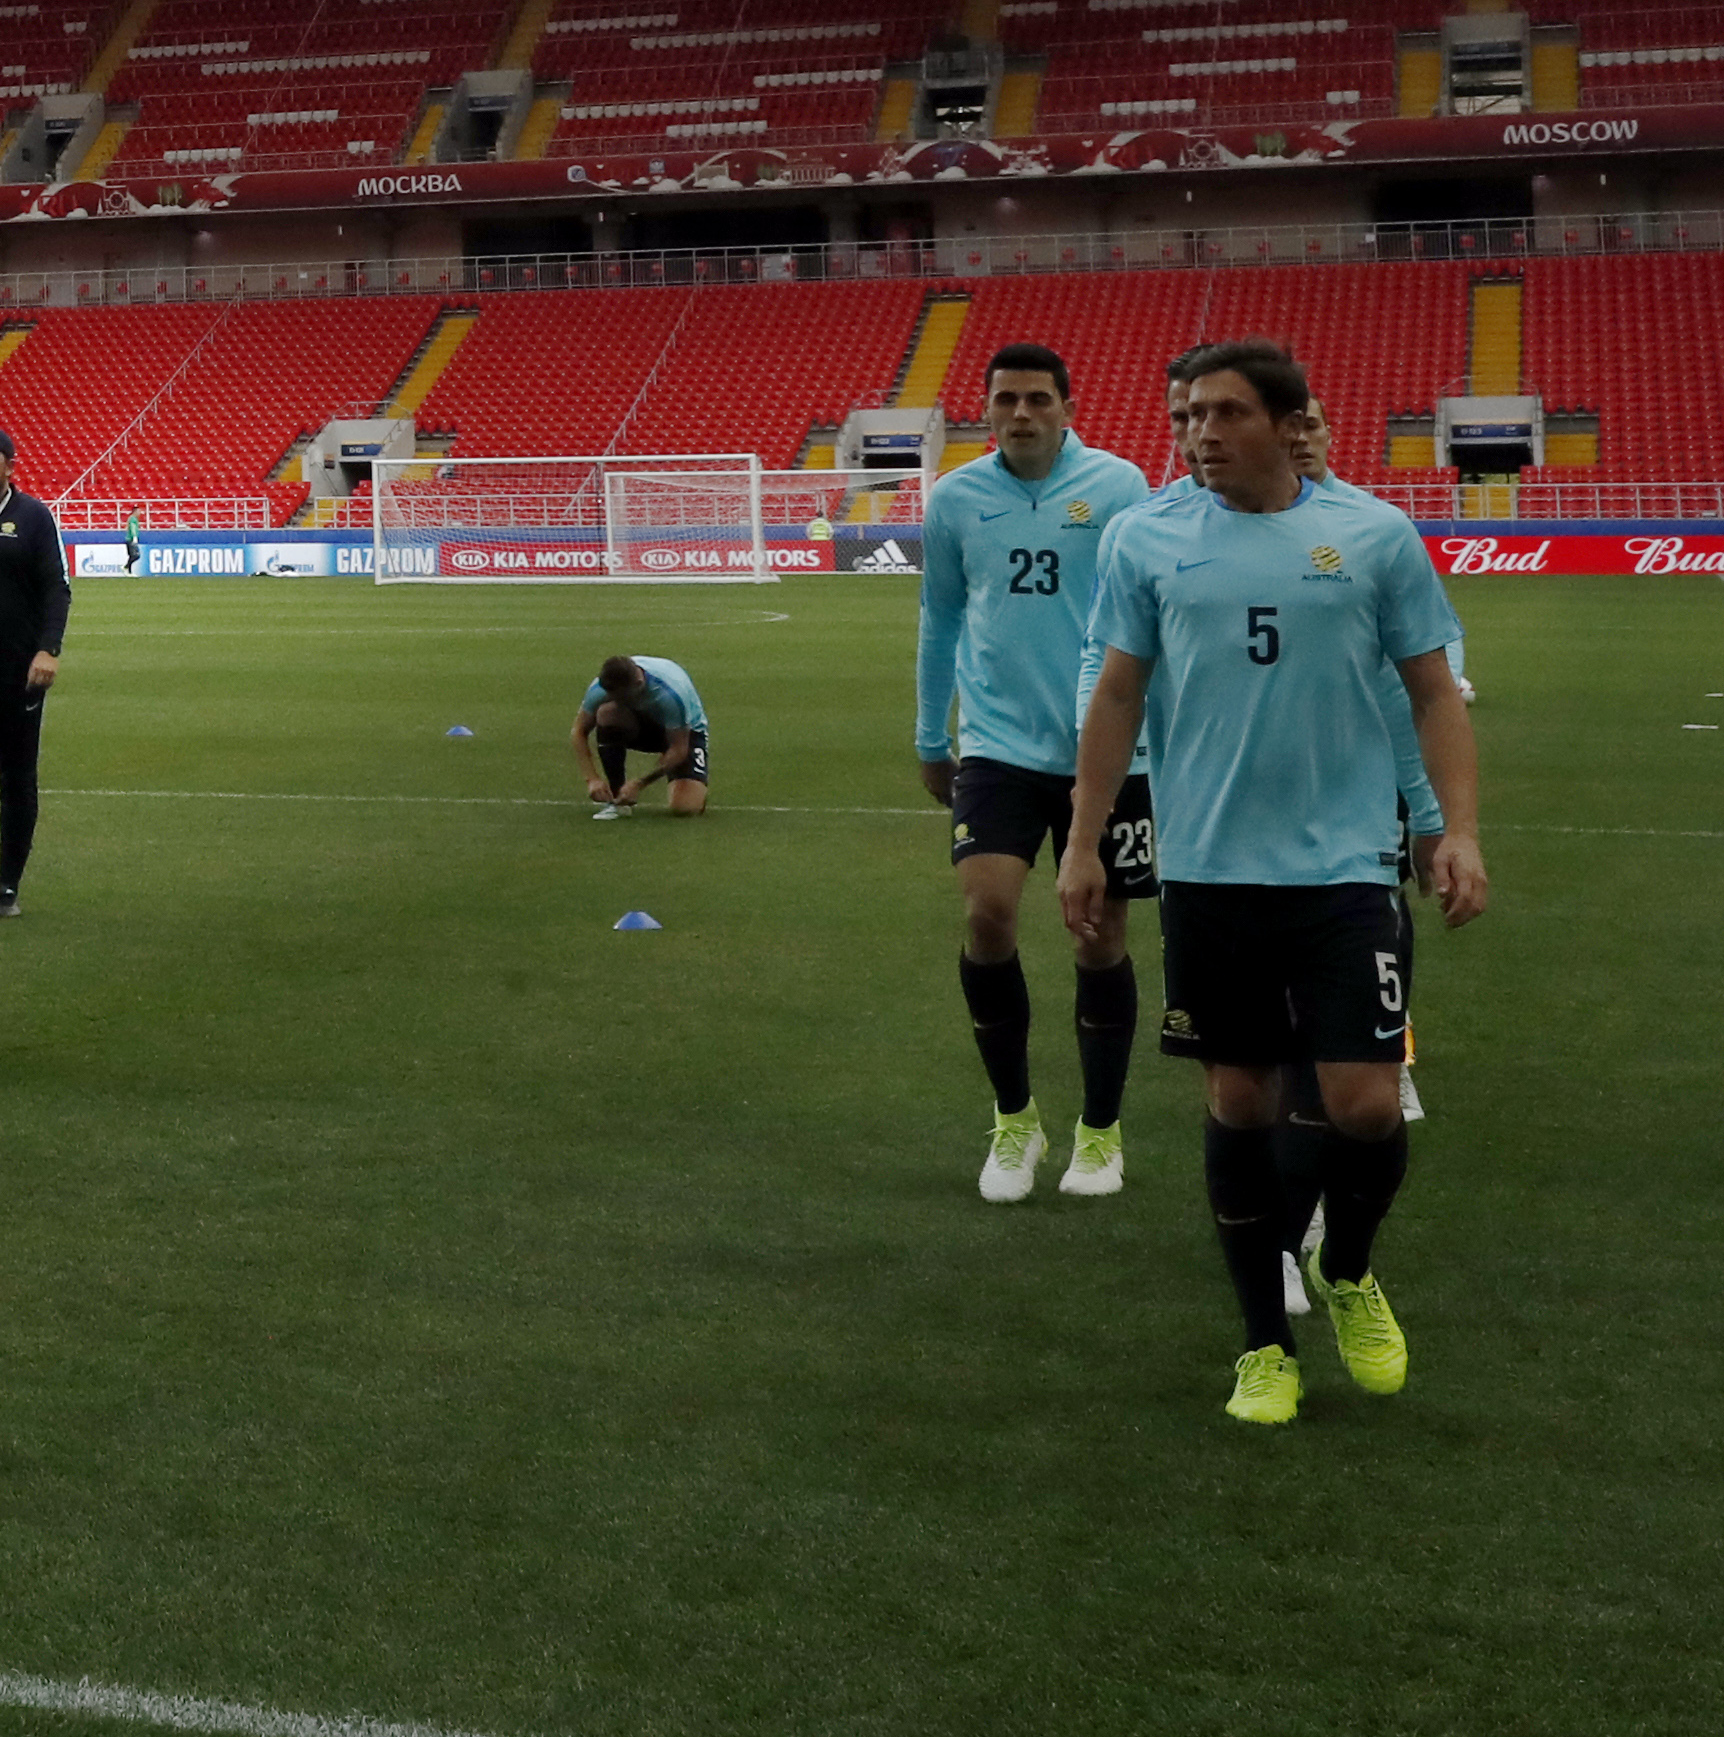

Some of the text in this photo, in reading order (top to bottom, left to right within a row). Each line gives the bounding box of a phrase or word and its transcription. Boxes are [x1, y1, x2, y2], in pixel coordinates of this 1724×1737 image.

[1502, 119, 1639, 146] MOSCOW
[356, 173, 462, 197] МОСКВА
[149, 548, 245, 574] GAZPROM
[456, 552, 487, 567] KIA
[493, 549, 623, 569] KIA MOTORS
[644, 551, 675, 567] KIA
[684, 549, 722, 568] KIA
[858, 562, 917, 573] adidas
[1440, 537, 1551, 575] Bud
[1008, 547, 1060, 596] 23
[1300, 572, 1354, 584] AUSTRALIA
[1247, 606, 1280, 666] 5
[1112, 817, 1152, 869] 23
[1374, 951, 1403, 1012] 5
